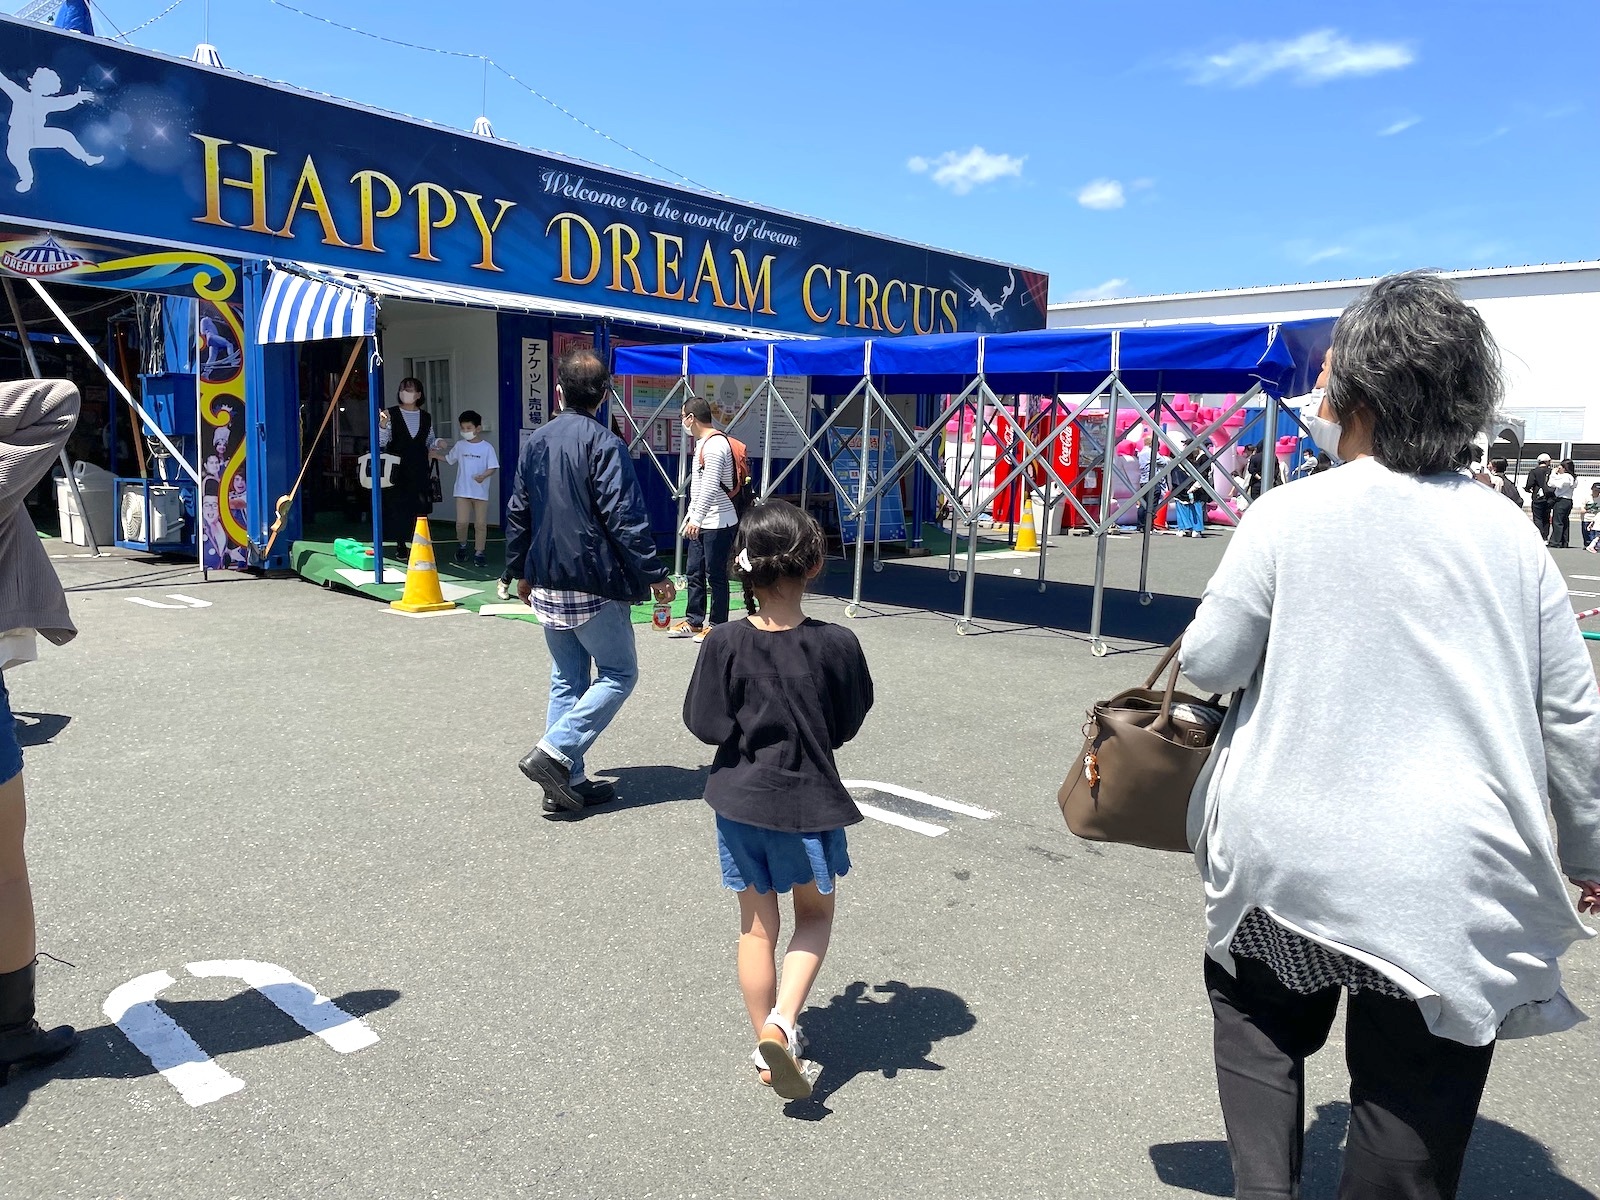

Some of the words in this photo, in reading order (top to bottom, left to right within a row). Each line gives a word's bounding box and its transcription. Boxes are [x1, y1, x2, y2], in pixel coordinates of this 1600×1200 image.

[189, 132, 518, 272] HAPPY
[545, 211, 778, 316] DREAM
[802, 263, 959, 336] CIRCUS
[541, 170, 628, 209] Welcome
[630, 196, 650, 214] to
[653, 198, 681, 221] the
[682, 211, 735, 233] world
[733, 218, 756, 242] of
[752, 221, 801, 247] dream
[3, 255, 37, 274] DREAM
[39, 261, 73, 274] CIRCUS
[527, 342, 542, 426] チケット売場
[1058, 426, 1073, 467] Coca-Cola
